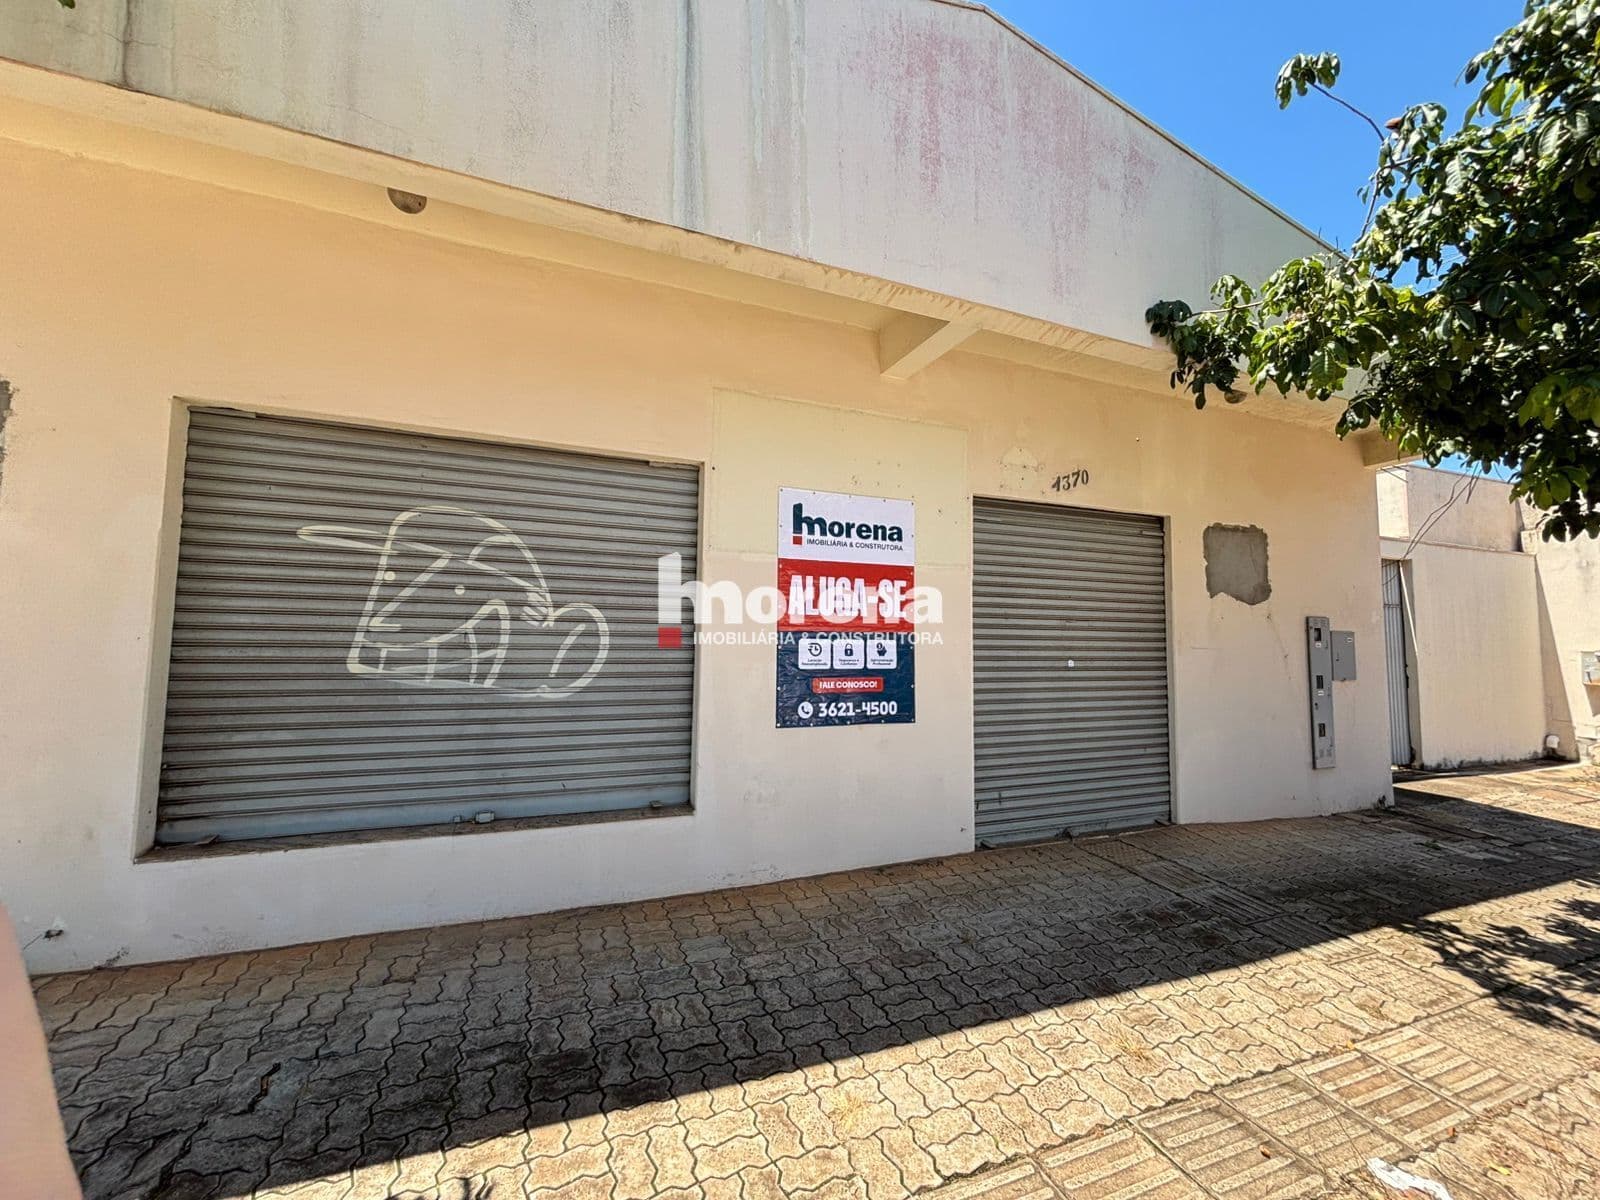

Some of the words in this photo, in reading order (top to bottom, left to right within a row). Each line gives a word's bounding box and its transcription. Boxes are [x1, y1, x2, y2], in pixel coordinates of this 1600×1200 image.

[792, 503, 904, 542] morena
[806, 538, 848, 548] IMOBILIÁRIA
[855, 541, 904, 551] CONSTRUTORA
[788, 574, 907, 618] ALUGA-SE
[818, 701, 898, 717] 3621-4500
